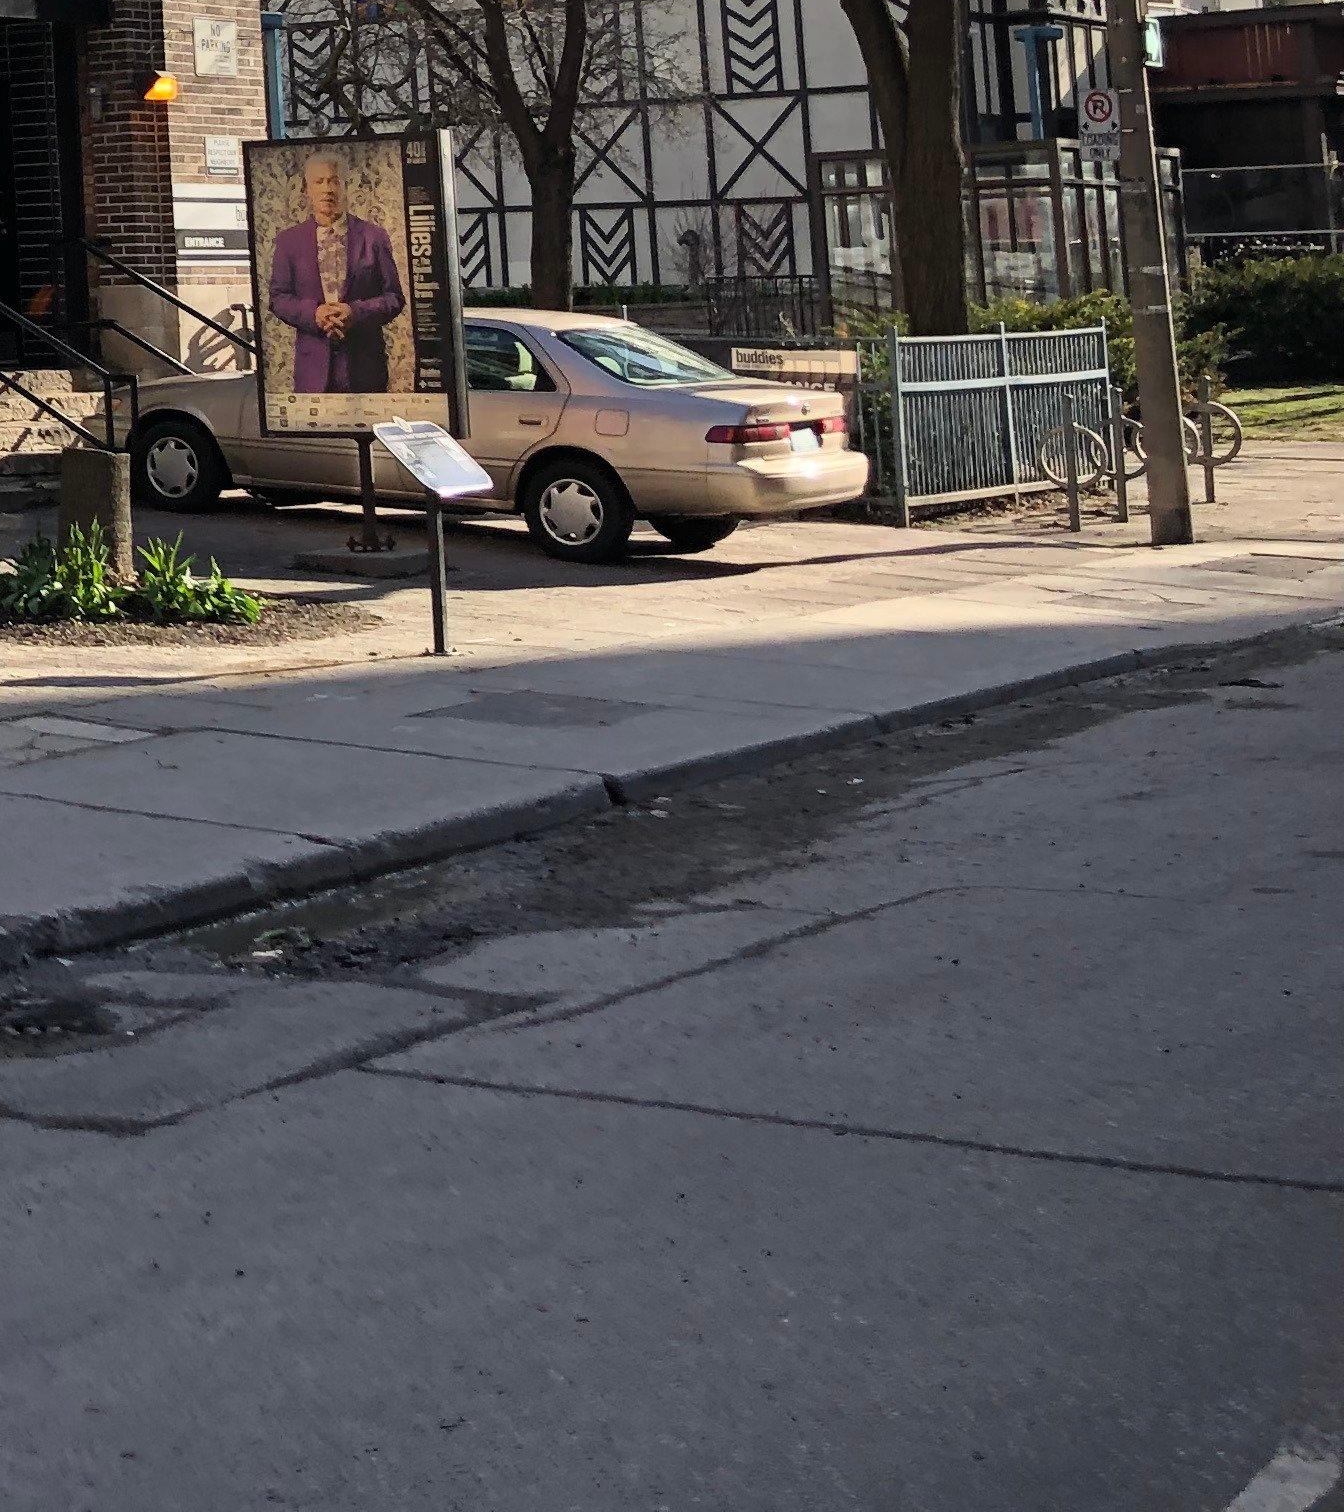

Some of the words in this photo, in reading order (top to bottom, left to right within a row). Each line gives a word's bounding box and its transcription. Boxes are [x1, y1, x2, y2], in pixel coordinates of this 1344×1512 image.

[210, 24, 221, 37] NO
[184, 236, 226, 248] ENTRANCE
[736, 350, 784, 366] buddies
